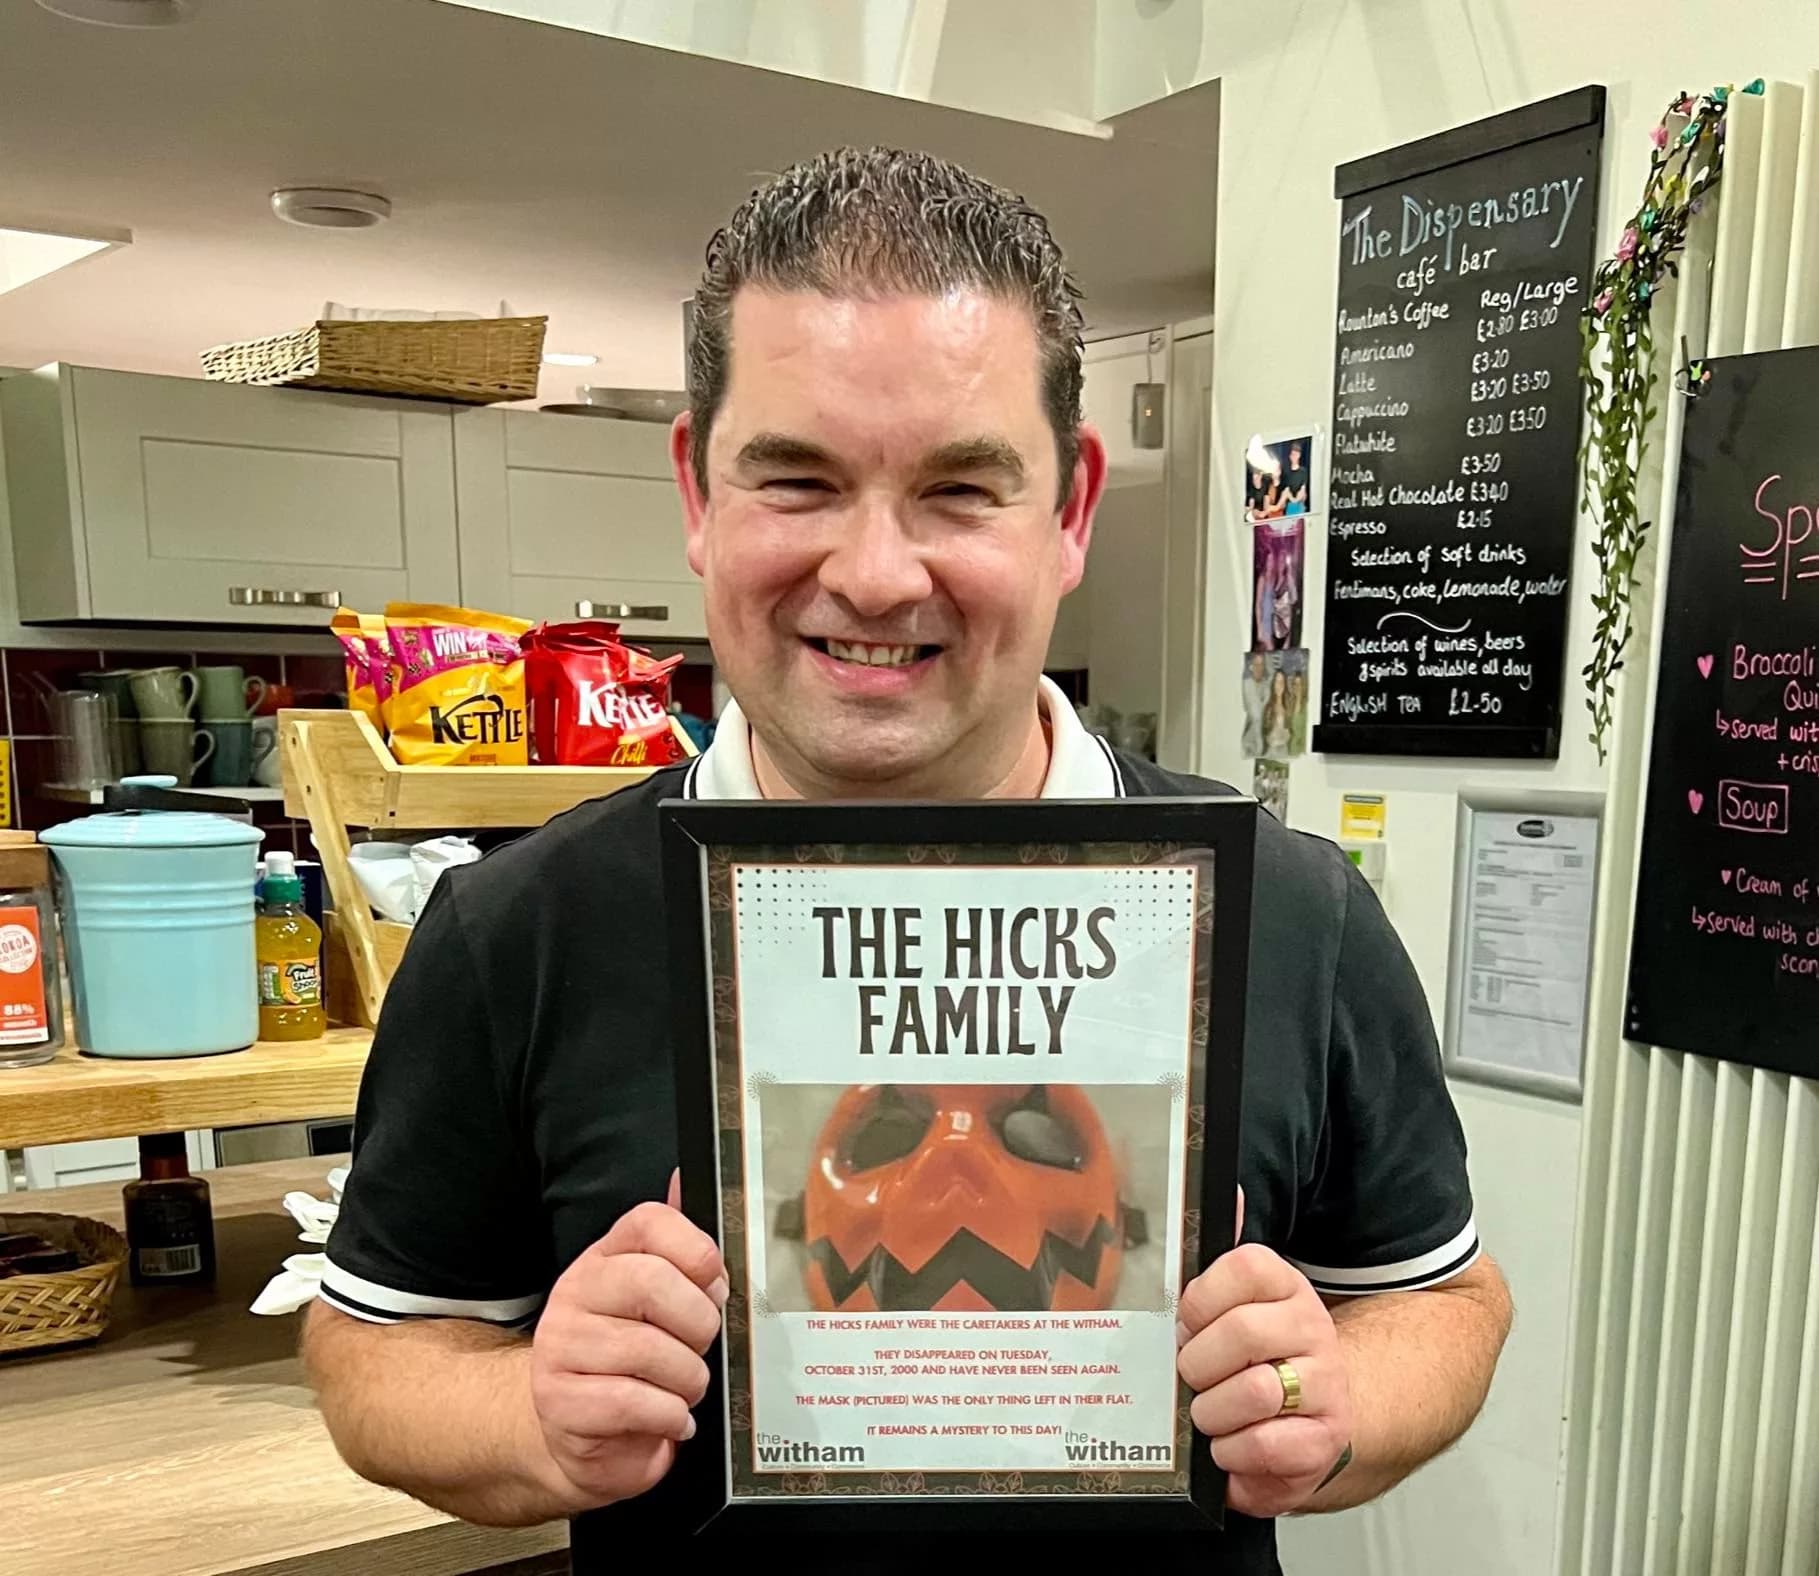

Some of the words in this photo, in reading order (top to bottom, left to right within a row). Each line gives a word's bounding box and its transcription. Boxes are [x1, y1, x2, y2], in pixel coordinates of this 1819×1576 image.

[1342, 205, 1393, 265] The
[1399, 177, 1583, 271] Dispensary
[1396, 254, 1438, 296] café
[1459, 243, 1497, 276] bar
[1480, 276, 1578, 312] Reg/Large
[1403, 302, 1449, 329] Coffee
[1341, 338, 1414, 365] Americano
[1338, 372, 1376, 395] Latte
[1336, 397, 1409, 428] Cappuccino
[1332, 464, 1375, 484] Mocha
[1331, 490, 1358, 509] Real
[1361, 485, 1385, 507] Hot
[1389, 480, 1465, 505] Chocolate
[1330, 518, 1387, 541] Espresso
[1739, 474, 1819, 600] Sp
[1351, 546, 1413, 566] Selection
[1417, 546, 1432, 573] of
[1441, 543, 1472, 568] soft
[1478, 544, 1527, 565] drinks
[433, 632, 467, 656] WIN
[1347, 635, 1409, 655] Selection
[1415, 635, 1428, 661] of
[1484, 631, 1525, 650] beers
[1417, 659, 1478, 677] available
[1482, 658, 1499, 674] all
[1503, 658, 1533, 691] day
[1733, 644, 1817, 679] Broccoli
[429, 694, 523, 744] KETTLE
[1731, 717, 1778, 740] served
[1726, 786, 1779, 828] Soup
[1736, 867, 1782, 896] Cream
[1793, 878, 1809, 903] of
[812, 906, 923, 979] THE
[944, 906, 1117, 980] HICKS
[1763, 920, 1797, 944] with
[858, 985, 1076, 1055] FAMILY
[807, 1320, 826, 1329] THE
[830, 1320, 862, 1329] HICKS
[865, 1320, 903, 1329] FAMILY
[907, 1320, 937, 1329] WERE
[941, 1319, 960, 1329] THE
[963, 1319, 1031, 1329] CARETAKERS
[1033, 1319, 1047, 1329] AT
[1051, 1319, 1070, 1329] THE
[1074, 1319, 1122, 1329] WITHAM.
[874, 1350, 901, 1360] THEY
[904, 1350, 976, 1360] DISAPPEARED
[979, 1350, 997, 1360] ON
[1000, 1350, 1052, 1361] TUESDAY,
[805, 1365, 855, 1375] OCTOBER
[858, 1365, 887, 1377] 31ST,
[892, 1365, 918, 1375] 2000
[921, 1365, 946, 1375] AND
[950, 1365, 979, 1375] HAVE
[982, 1365, 1017, 1375] NEVER
[1020, 1365, 1048, 1375] BEEN
[1051, 1365, 1078, 1375] SEEN
[1081, 1365, 1121, 1375] AGAIN.
[796, 1396, 815, 1405] THE
[818, 1396, 850, 1405] MASK
[853, 1395, 909, 1406] (PICTURED)
[912, 1395, 939, 1405] WAS
[942, 1396, 961, 1405] THE
[964, 1395, 994, 1405] ONLY
[997, 1395, 1031, 1405] THING
[1034, 1395, 1056, 1405] LEFT
[1059, 1395, 1071, 1405] IN
[1074, 1395, 1104, 1405] THEIR
[1106, 1395, 1133, 1405] FLAT.
[757, 1432, 781, 1445] the
[867, 1426, 876, 1435] IT
[879, 1426, 927, 1435] REMAINS
[930, 1426, 939, 1435] A
[941, 1425, 990, 1435] MYSTERY
[992, 1425, 1007, 1435] TO
[1010, 1425, 1033, 1435] THIS
[1065, 1431, 1089, 1444] the
[758, 1440, 865, 1463] witham
[1065, 1437, 1171, 1461] witham
